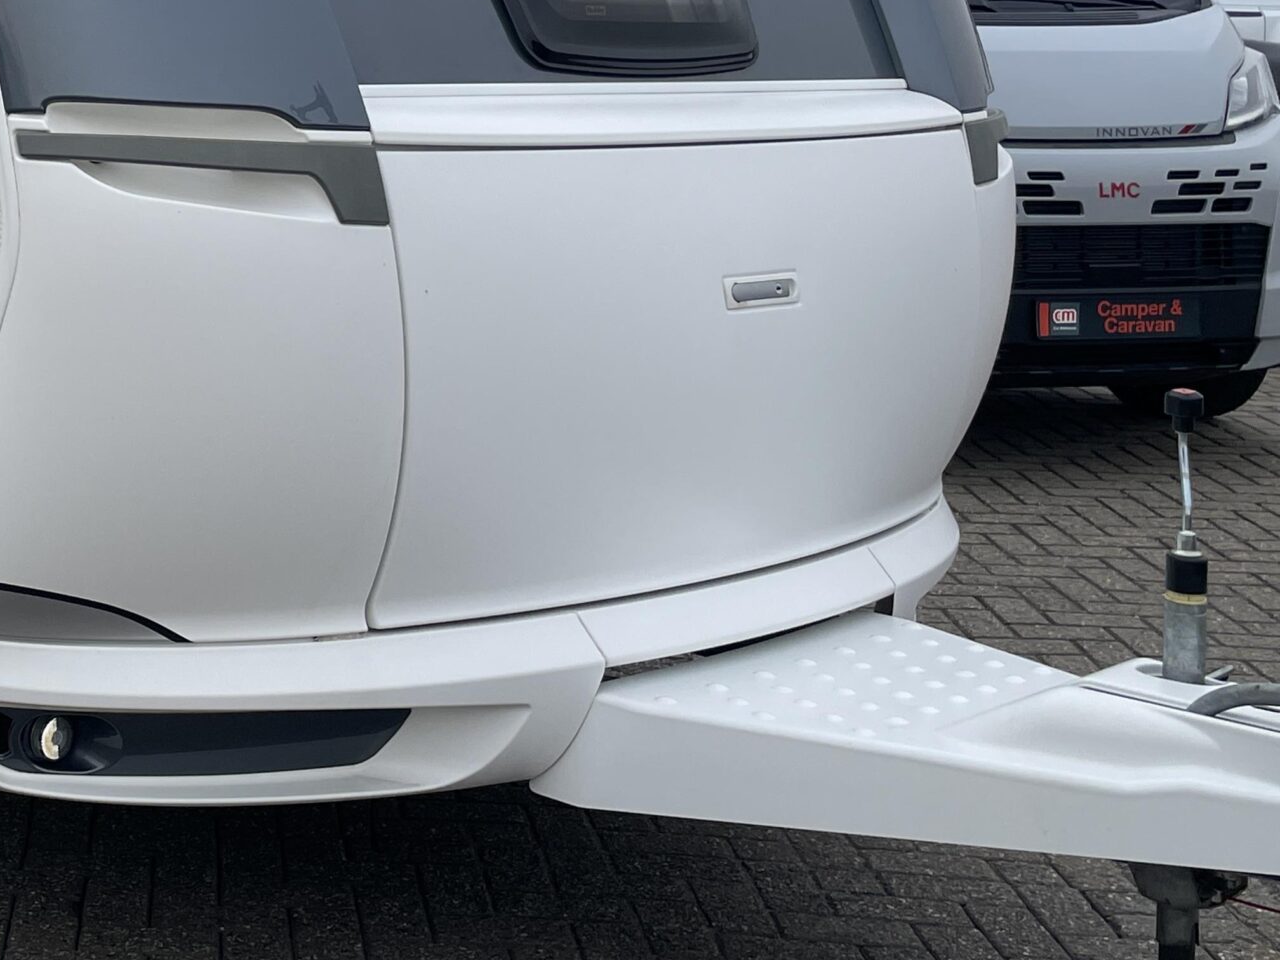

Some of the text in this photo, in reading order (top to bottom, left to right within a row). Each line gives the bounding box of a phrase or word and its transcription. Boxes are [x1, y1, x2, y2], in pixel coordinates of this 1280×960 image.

[1096, 126, 1173, 137] INNOVAN
[1099, 182, 1141, 198] LMC
[1097, 298, 1183, 319] Camper &
[1104, 317, 1176, 334] Caravan
